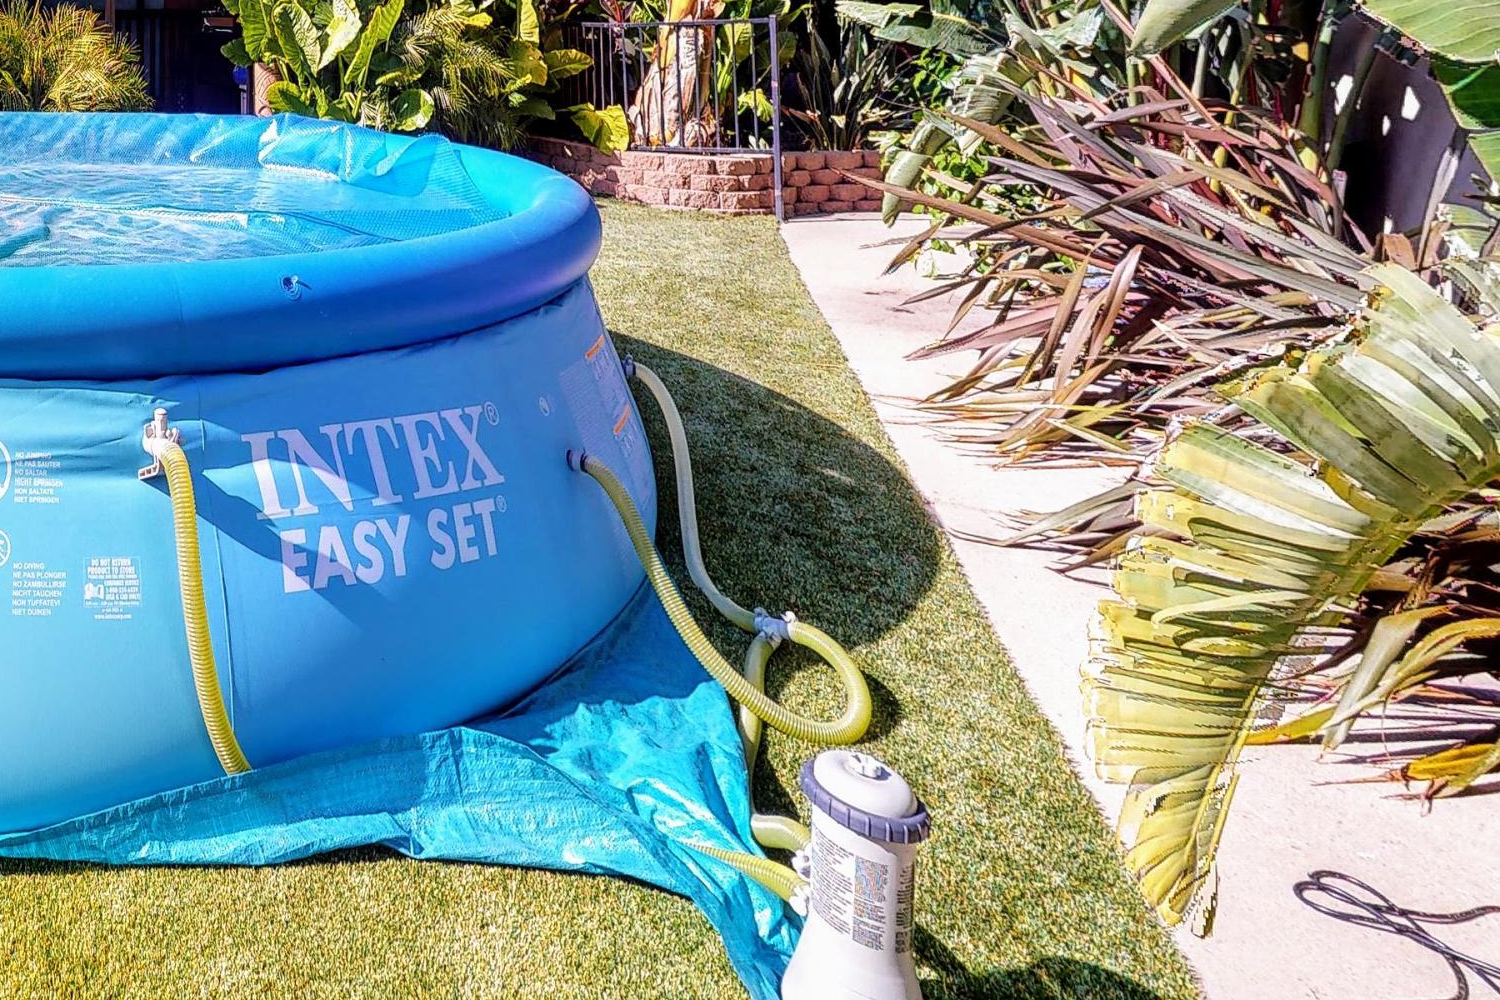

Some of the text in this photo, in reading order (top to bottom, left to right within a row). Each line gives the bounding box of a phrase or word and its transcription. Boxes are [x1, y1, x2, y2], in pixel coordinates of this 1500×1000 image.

[87, 566, 110, 574] PRODUCT
[280, 498, 498, 594] EASY SET
